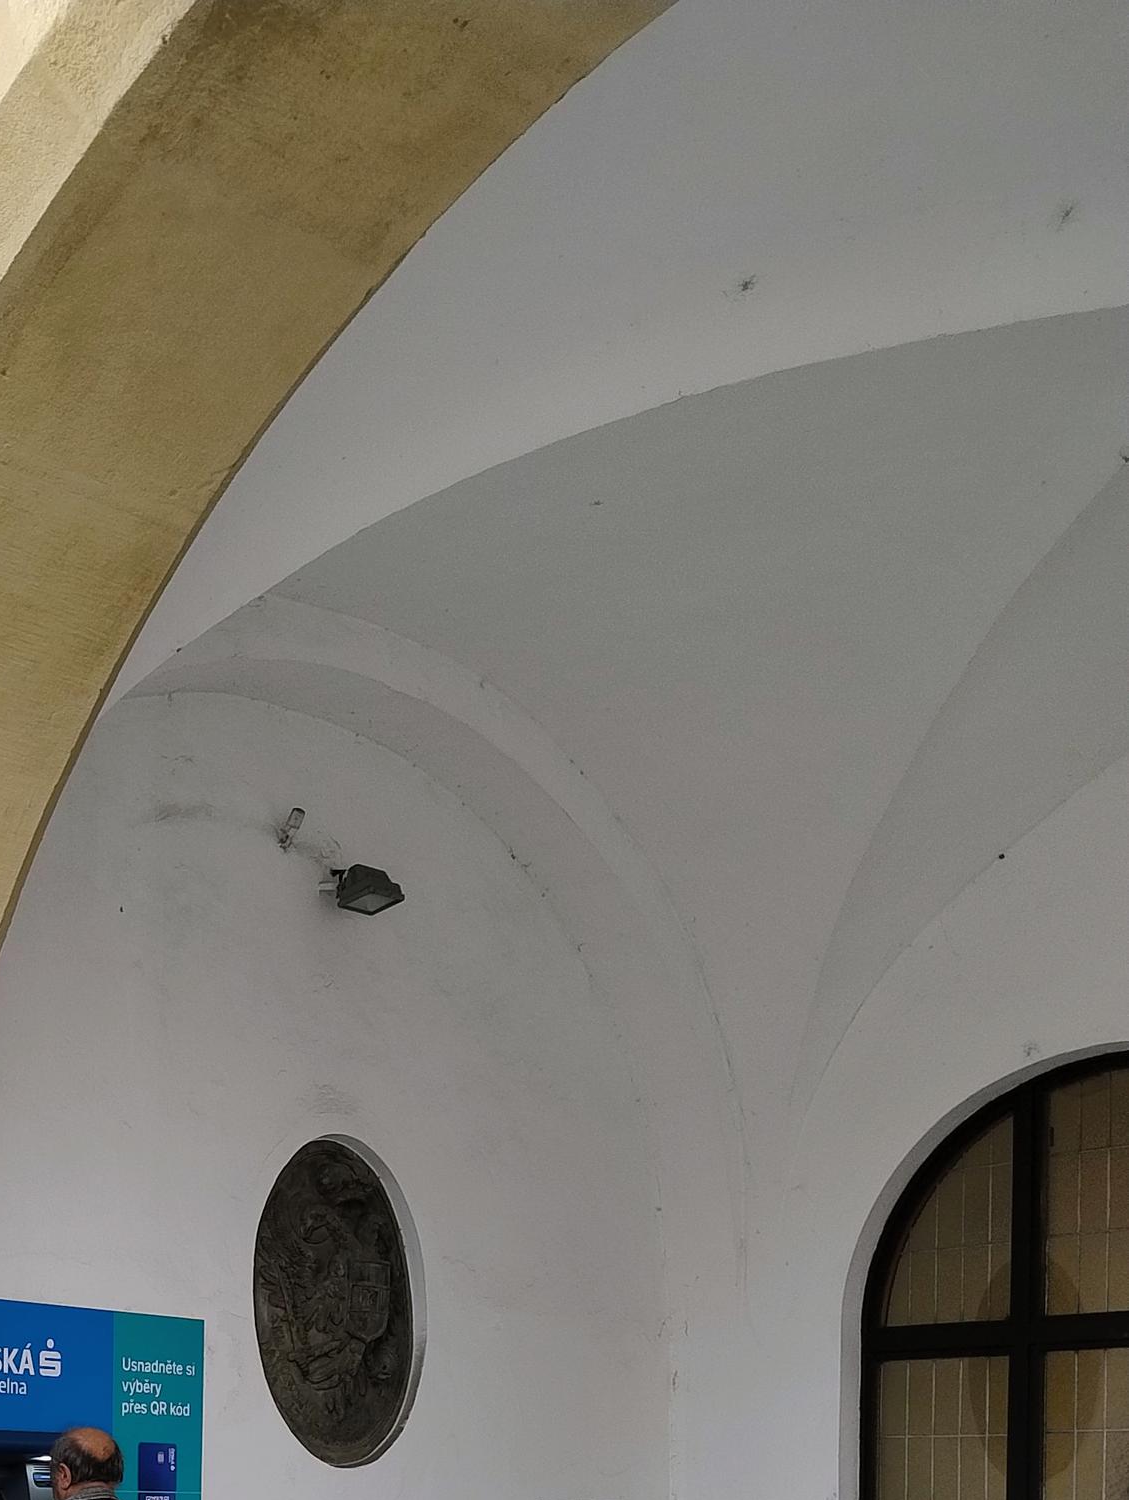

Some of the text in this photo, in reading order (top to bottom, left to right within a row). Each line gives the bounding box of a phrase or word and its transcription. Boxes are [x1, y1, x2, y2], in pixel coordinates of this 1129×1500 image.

[122, 1357, 196, 1376] Usnadněte si
[121, 1378, 162, 1398] výběry
[121, 1399, 191, 1417] přes QR kód
